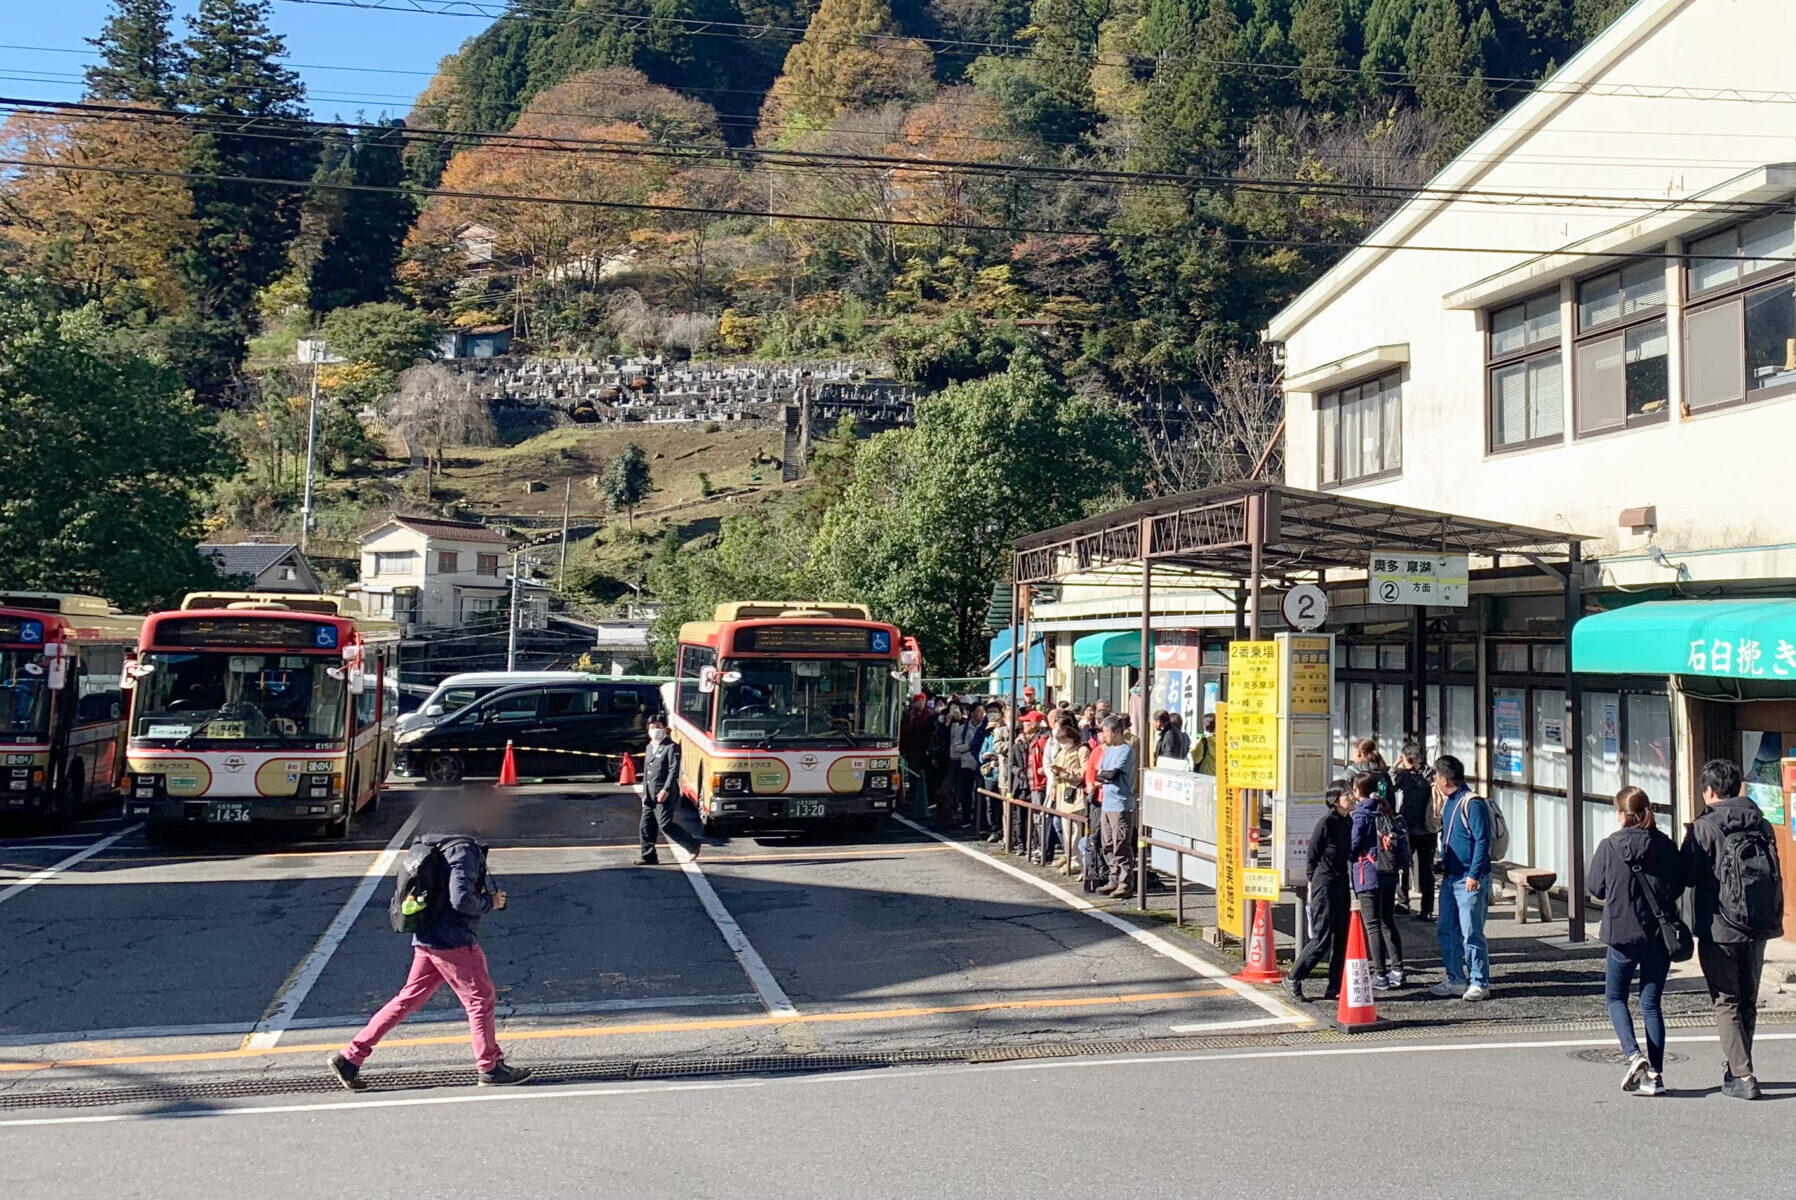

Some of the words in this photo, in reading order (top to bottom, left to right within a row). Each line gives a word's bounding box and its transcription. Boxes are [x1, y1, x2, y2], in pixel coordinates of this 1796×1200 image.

[1374, 558, 1431, 573] 奥多摩湖
[1412, 582, 1431, 592] 方面
[1298, 594, 1315, 619] 2
[1231, 645, 1275, 659] 2番乗場
